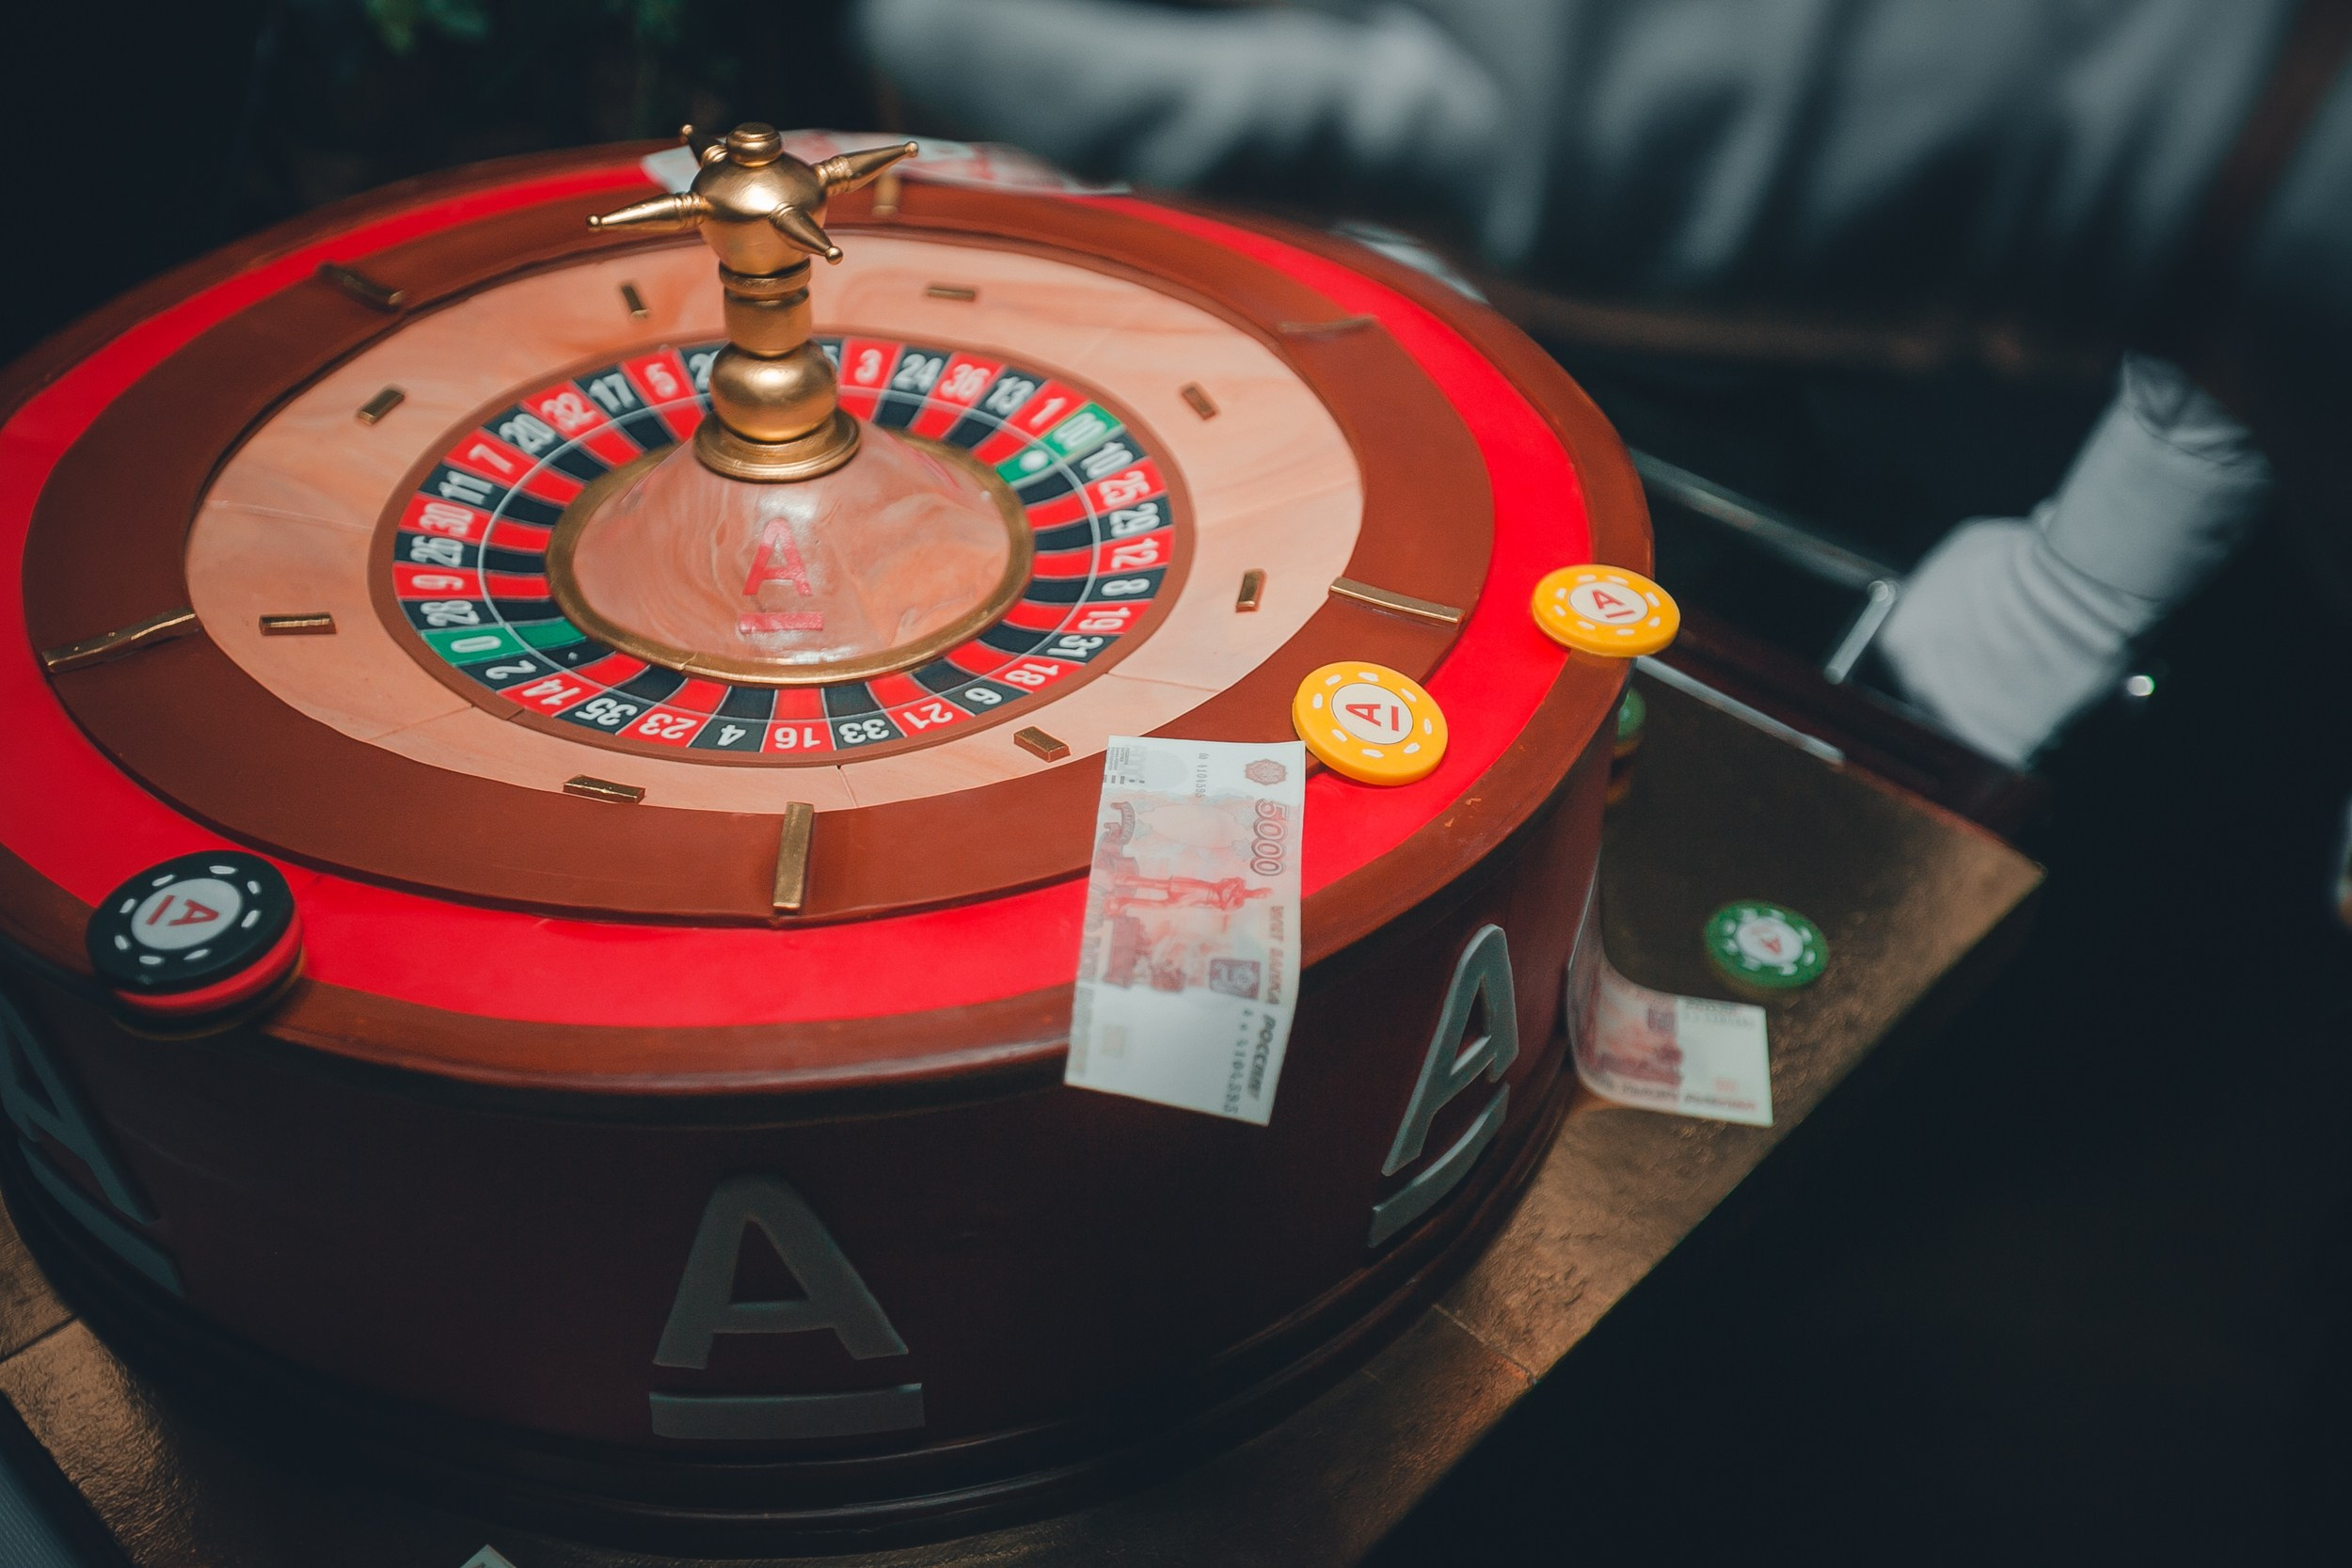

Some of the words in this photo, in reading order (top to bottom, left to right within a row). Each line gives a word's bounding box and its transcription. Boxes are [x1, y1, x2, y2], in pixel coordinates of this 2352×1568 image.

[644, 362, 678, 397] 5
[689, 350, 719, 392] 2
[854, 349, 883, 384] 3
[892, 353, 944, 392] 24
[941, 363, 991, 401] 36
[589, 372, 636, 408] 17
[985, 377, 1035, 416] 13
[541, 391, 596, 429] 32
[1029, 397, 1066, 428] 1
[499, 413, 556, 453] 20
[1053, 412, 1106, 450] 00
[469, 443, 513, 473] 7
[1081, 442, 1133, 480] 10
[438, 470, 495, 504] 11
[1098, 469, 1151, 506] 25
[419, 502, 473, 536] 30
[1109, 502, 1160, 539] 29
[409, 535, 464, 566] 26
[1111, 538, 1159, 569] 12
[412, 574, 464, 590] 9
[1101, 578, 1151, 596] 8
[421, 600, 480, 626] 28
[1078, 607, 1131, 630] 19
[450, 636, 501, 653] 0
[1047, 634, 1104, 658] 31
[485, 660, 537, 679] 2
[1005, 662, 1058, 686] 18
[521, 678, 581, 705] 14
[964, 688, 1003, 705] 6
[575, 697, 639, 725] 35
[638, 713, 697, 739] 23
[903, 703, 953, 729] 21
[717, 724, 747, 746] 4
[774, 727, 820, 748] 16
[838, 719, 890, 743] 33
[1249, 799, 1289, 877] 5000
[653, 1174, 909, 1370] A
